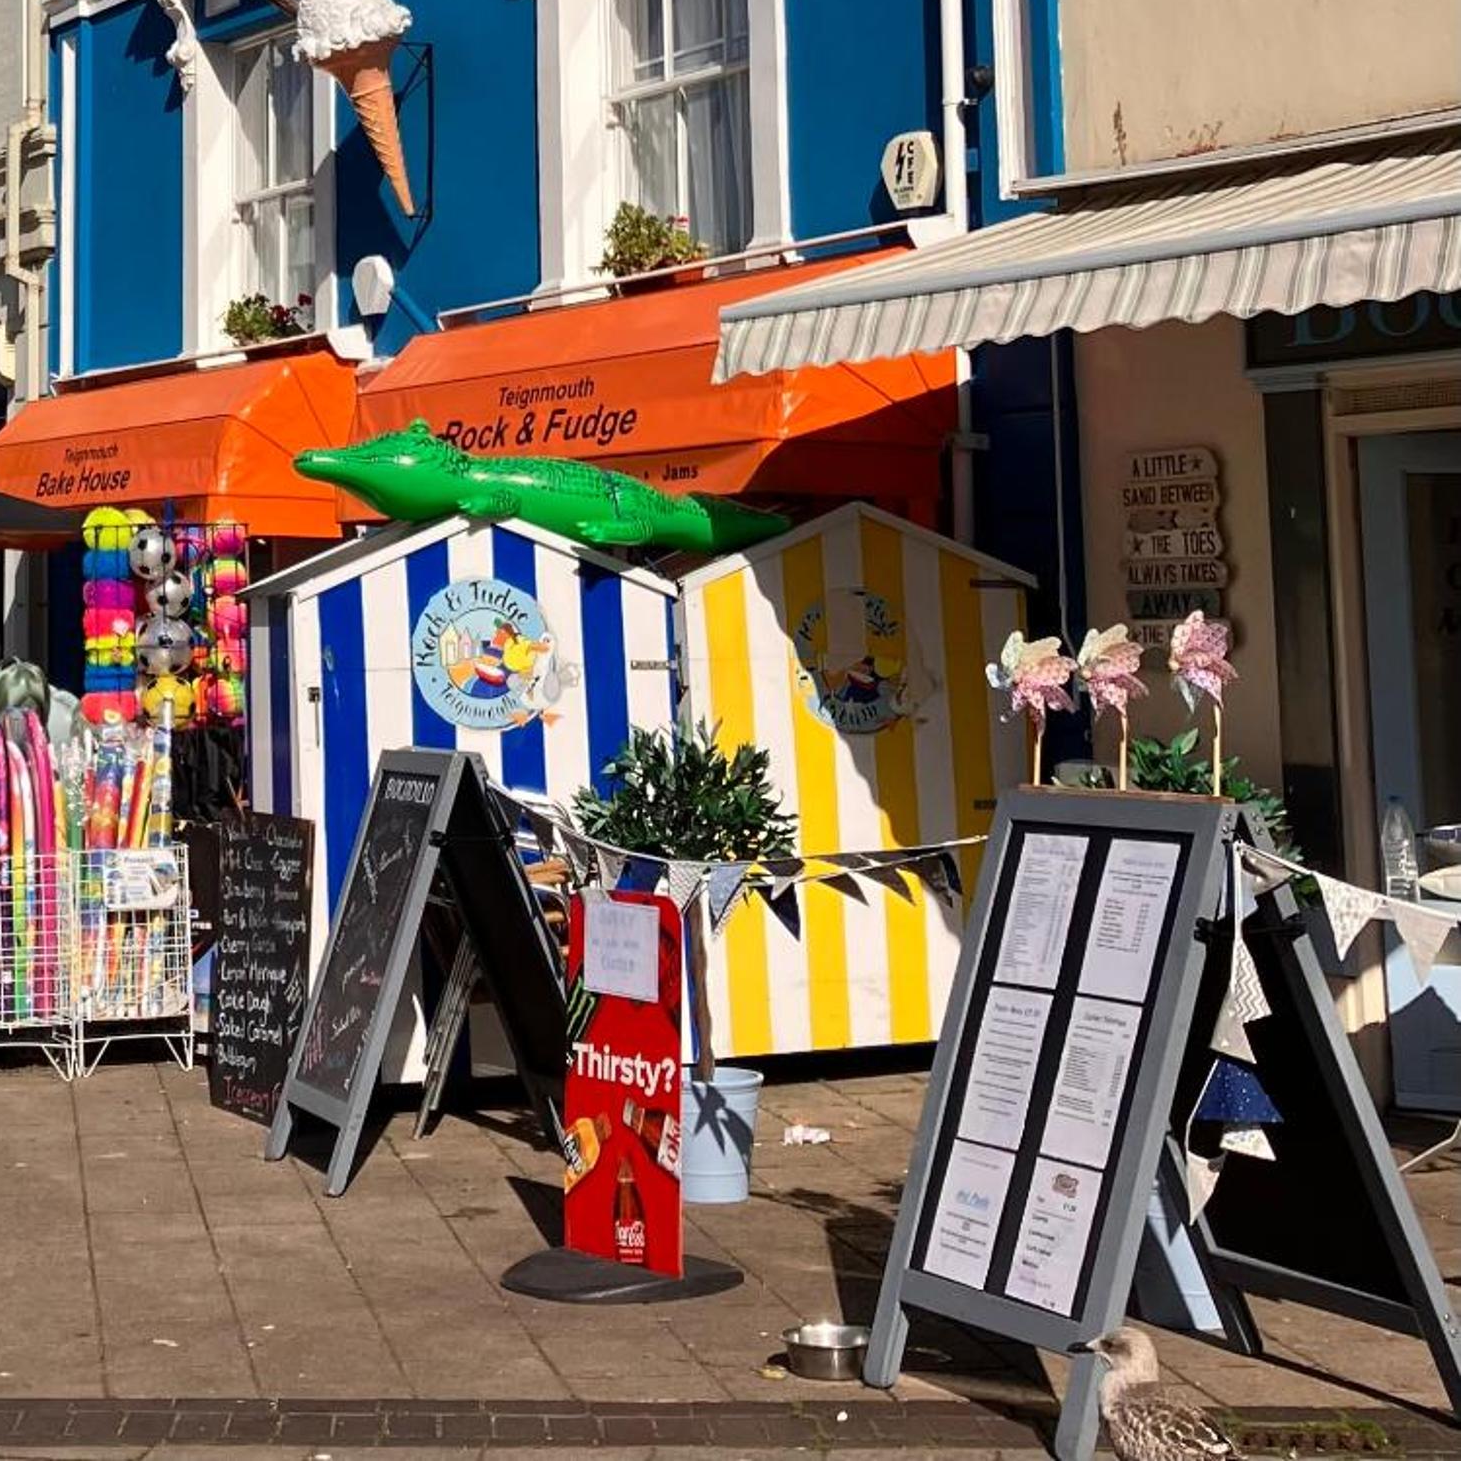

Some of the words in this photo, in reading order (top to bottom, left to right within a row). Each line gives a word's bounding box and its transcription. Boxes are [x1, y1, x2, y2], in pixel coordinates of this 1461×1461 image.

[499, 375, 595, 409] Teignmouth
[444, 416, 508, 451] Rock
[514, 411, 536, 445] &
[542, 403, 638, 447] Fudge
[62, 442, 119, 467] Teignmouth
[1132, 457, 1141, 477] A
[1144, 455, 1188, 477] LITTLE
[36, 470, 75, 498] Bake
[76, 467, 131, 494] House
[662, 463, 699, 482] Jams
[1123, 486, 1156, 507] SAND
[1160, 483, 1214, 506] BETWEEN
[1151, 536, 1171, 554] THE
[1183, 530, 1217, 555] TOES
[1128, 563, 1177, 585] ALWAYS
[1179, 563, 1217, 584] TAKES
[1140, 592, 1191, 612] AWAY
[415, 611, 446, 668] Rock
[468, 579, 529, 624] Fudge
[1142, 624, 1164, 644] THE
[571, 1041, 677, 1098] Thirsty?
